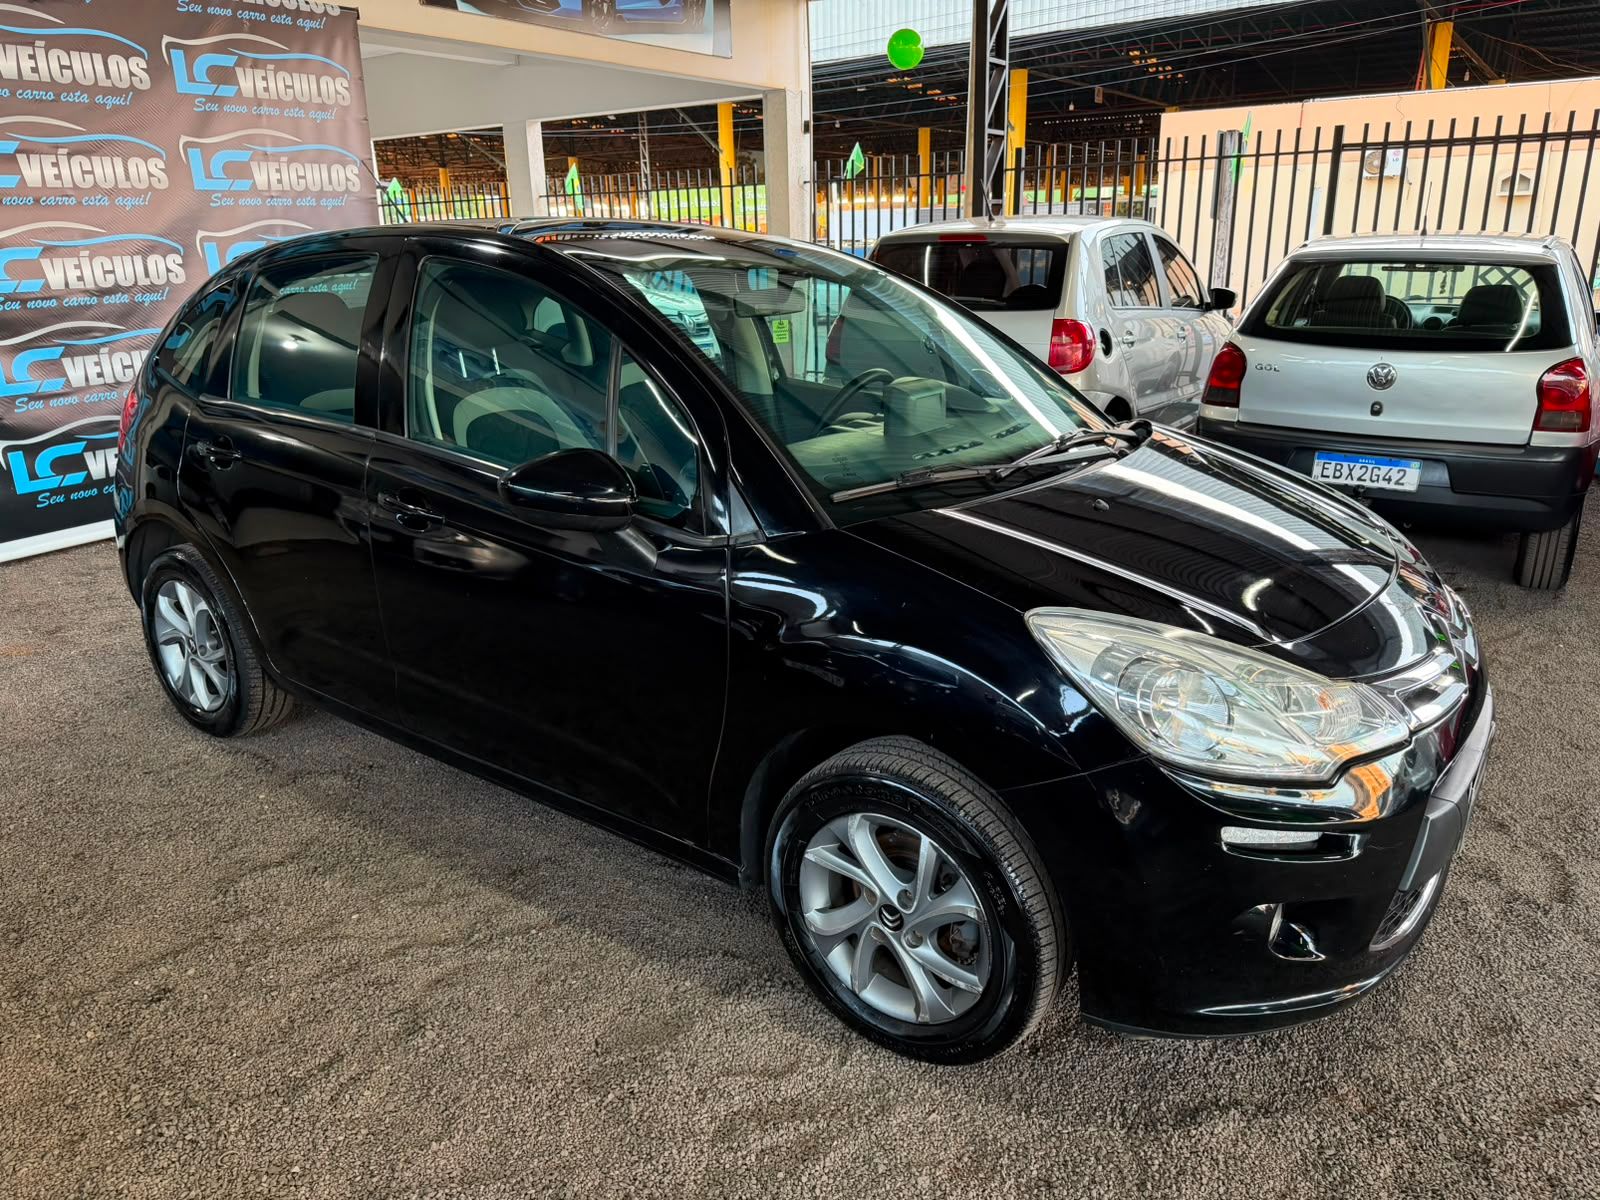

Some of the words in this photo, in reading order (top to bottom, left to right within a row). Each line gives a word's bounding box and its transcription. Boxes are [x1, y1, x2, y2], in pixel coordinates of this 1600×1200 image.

[176, 0, 203, 12] Seu
[207, 7, 233, 17] novo
[236, 9, 266, 21] carro
[270, 14, 293, 25] esta
[296, 17, 326, 31] aqui!
[0, 40, 151, 90] VEÍCULOS
[171, 49, 239, 97] LC
[234, 64, 351, 106] VEÍCULOS
[16, 88, 55, 100] carro
[60, 90, 89, 104] esta
[95, 91, 133, 109] aqui!
[193, 98, 219, 112] Seu
[223, 103, 248, 113] novo
[252, 104, 280, 116] carro
[284, 107, 305, 118] esta
[308, 108, 337, 121] aqui!
[16, 148, 169, 190] VEÍCULOS
[187, 147, 254, 191] LC
[250, 156, 361, 193] VEÍCULOS
[2, 194, 34, 206] novo
[39, 194, 77, 206] carro
[82, 194, 109, 206] esta
[115, 191, 152, 210] aqui!
[210, 193, 234, 207] Seu
[239, 197, 262, 206] novo
[266, 196, 292, 206] carro
[296, 195, 317, 206] esta
[320, 194, 348, 210] aqui!
[40, 250, 186, 290] VEÍCULOS
[27, 298, 57, 309] novo
[63, 296, 98, 308] carro
[103, 292, 129, 304] esta
[134, 287, 169, 306] aqui!
[279, 286, 305, 295] carro
[308, 283, 328, 293] esta
[331, 279, 358, 294] aqui!
[1255, 363, 1280, 373] GOL
[14, 397, 44, 413] Seu
[50, 395, 79, 407] novo
[83, 390, 118, 403] carro
[7, 441, 88, 495] LC
[1320, 462, 1407, 486] EBX2G42
[36, 492, 65, 508] Seu
[70, 489, 98, 500] novo
